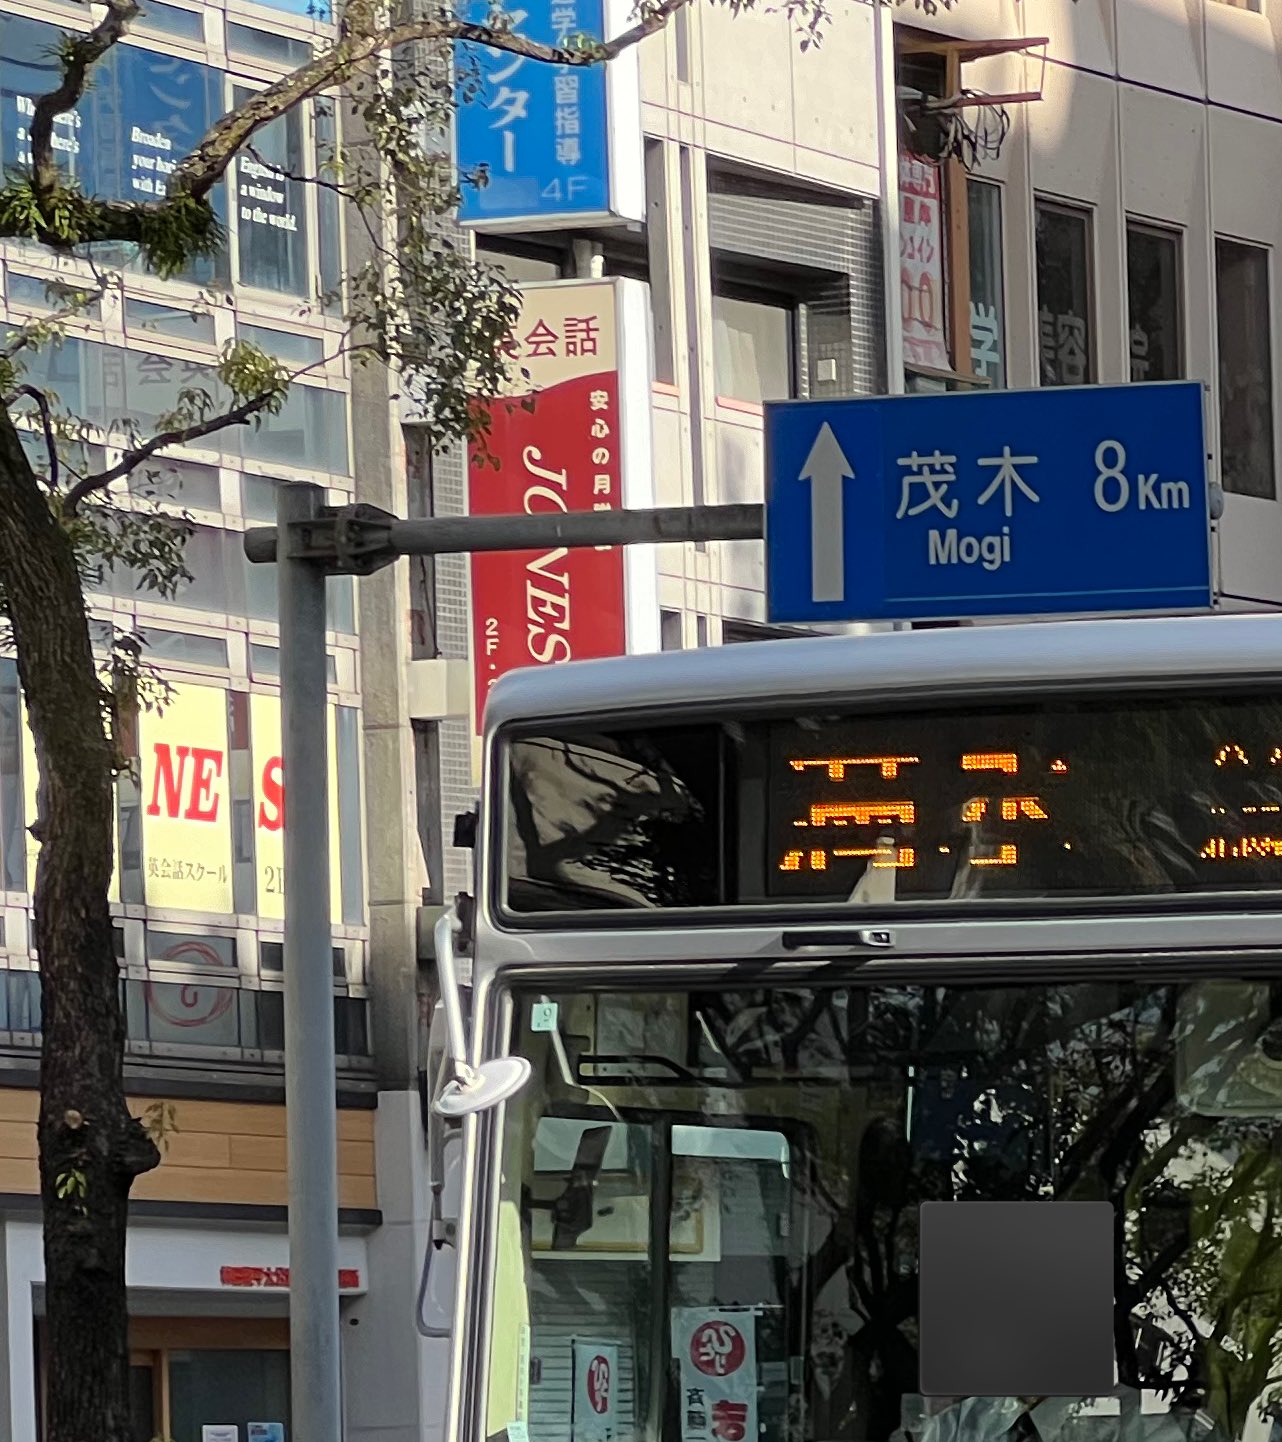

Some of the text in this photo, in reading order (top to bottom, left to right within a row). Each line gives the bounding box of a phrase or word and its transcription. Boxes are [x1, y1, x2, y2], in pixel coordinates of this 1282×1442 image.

[240, 183, 285, 205] a window
[541, 177, 588, 201] 4F
[241, 206, 252, 221] to
[253, 207, 267, 225] the
[896, 446, 1040, 519] 茂木
[1094, 439, 1190, 512] 8 Km
[928, 526, 1011, 571] Mogi
[148, 857, 229, 884] 英会話スクール
